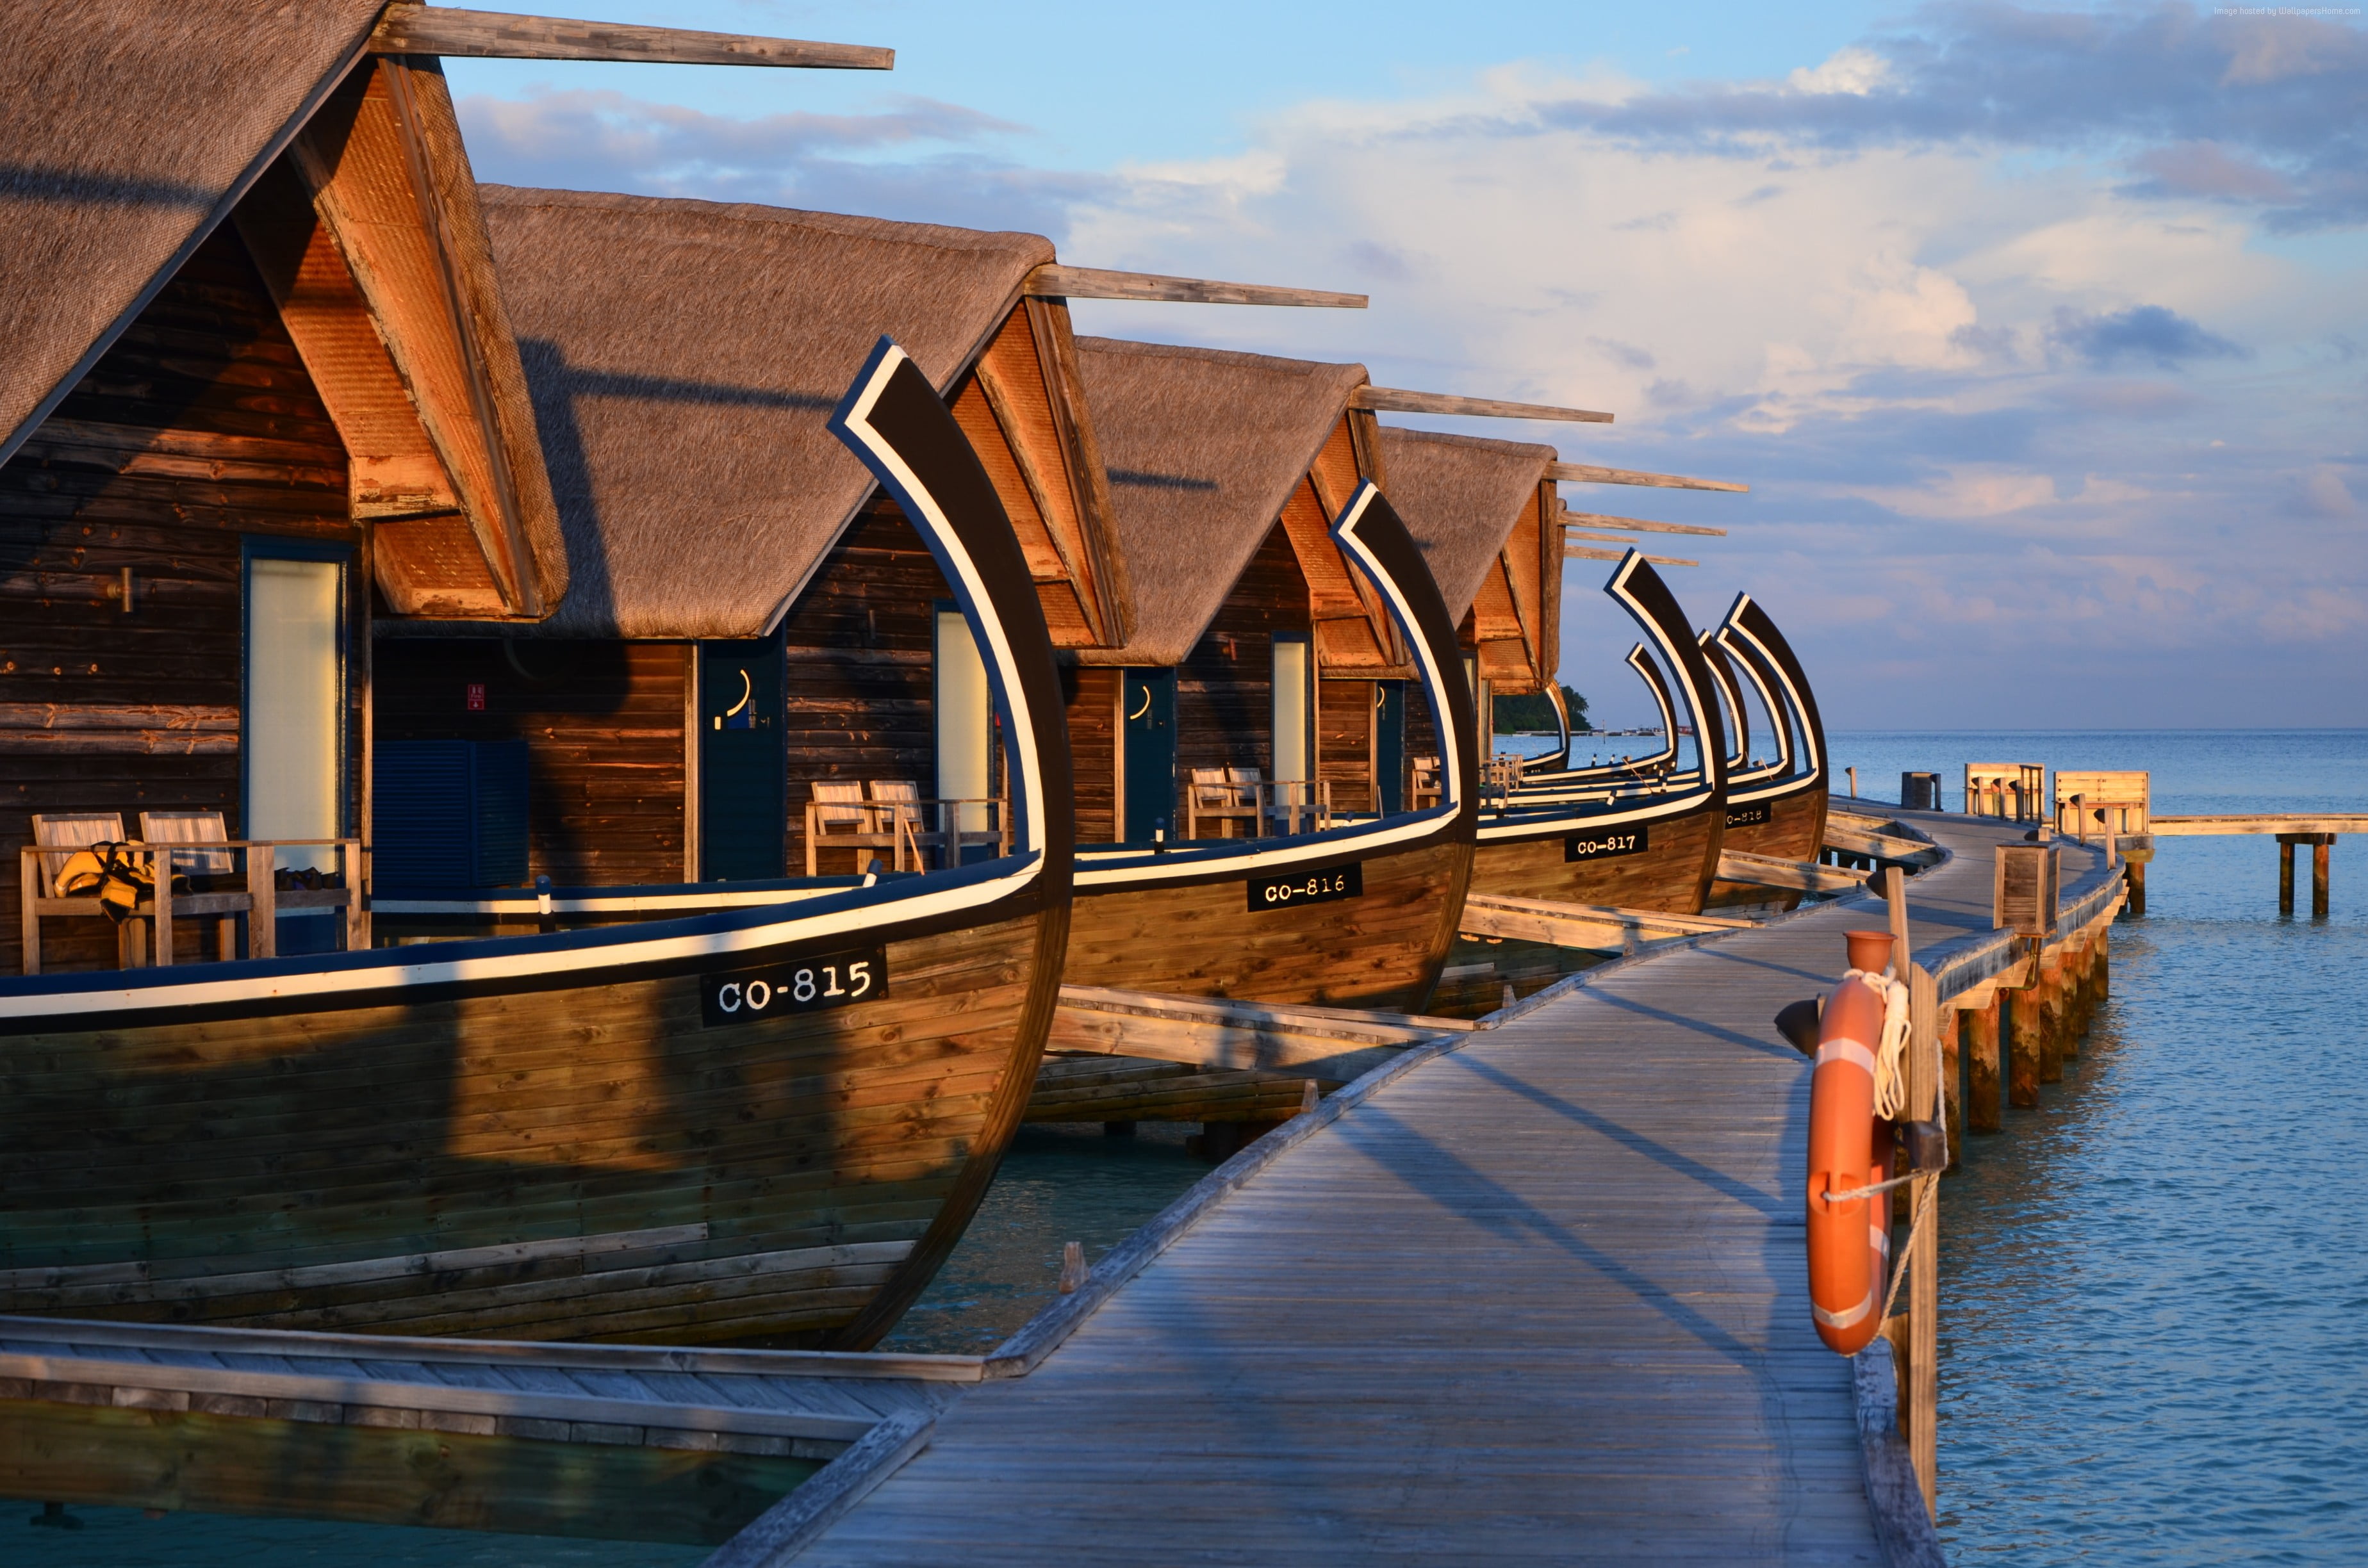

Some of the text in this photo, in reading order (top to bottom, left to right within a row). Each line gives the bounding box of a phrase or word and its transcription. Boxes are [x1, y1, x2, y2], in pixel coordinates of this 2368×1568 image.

[1727, 810, 1762, 824] O-818
[1577, 835, 1635, 854] CO-817
[1265, 875, 1344, 902] CO-816
[719, 961, 871, 1012] CO-815
